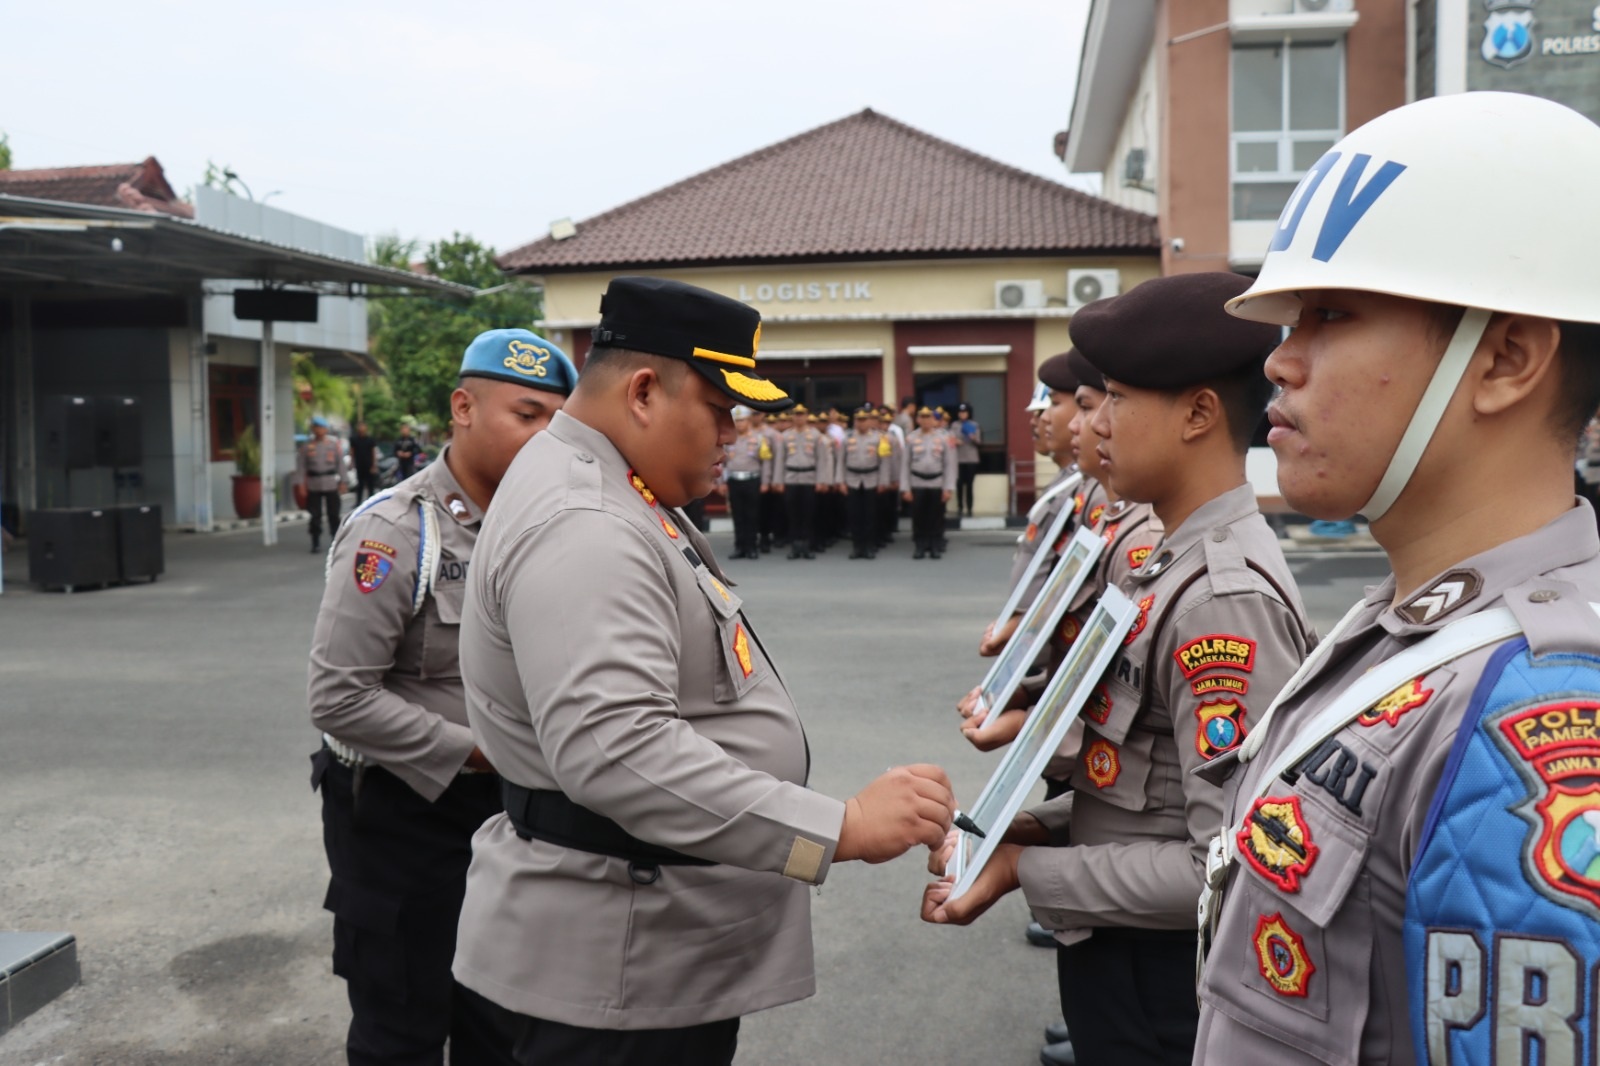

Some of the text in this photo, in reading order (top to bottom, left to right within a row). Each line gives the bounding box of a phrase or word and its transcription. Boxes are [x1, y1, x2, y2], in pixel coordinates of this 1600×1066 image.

[1542, 35, 1600, 55] POLRES
[738, 282, 872, 301] LOGISTIK
[1180, 639, 1249, 666] POLRES
[1188, 655, 1245, 670] PAMEKASAN
[1196, 678, 1243, 692] JAWA TIMUR
[1547, 757, 1592, 775] JAWA
[1424, 926, 1600, 1066] PR
